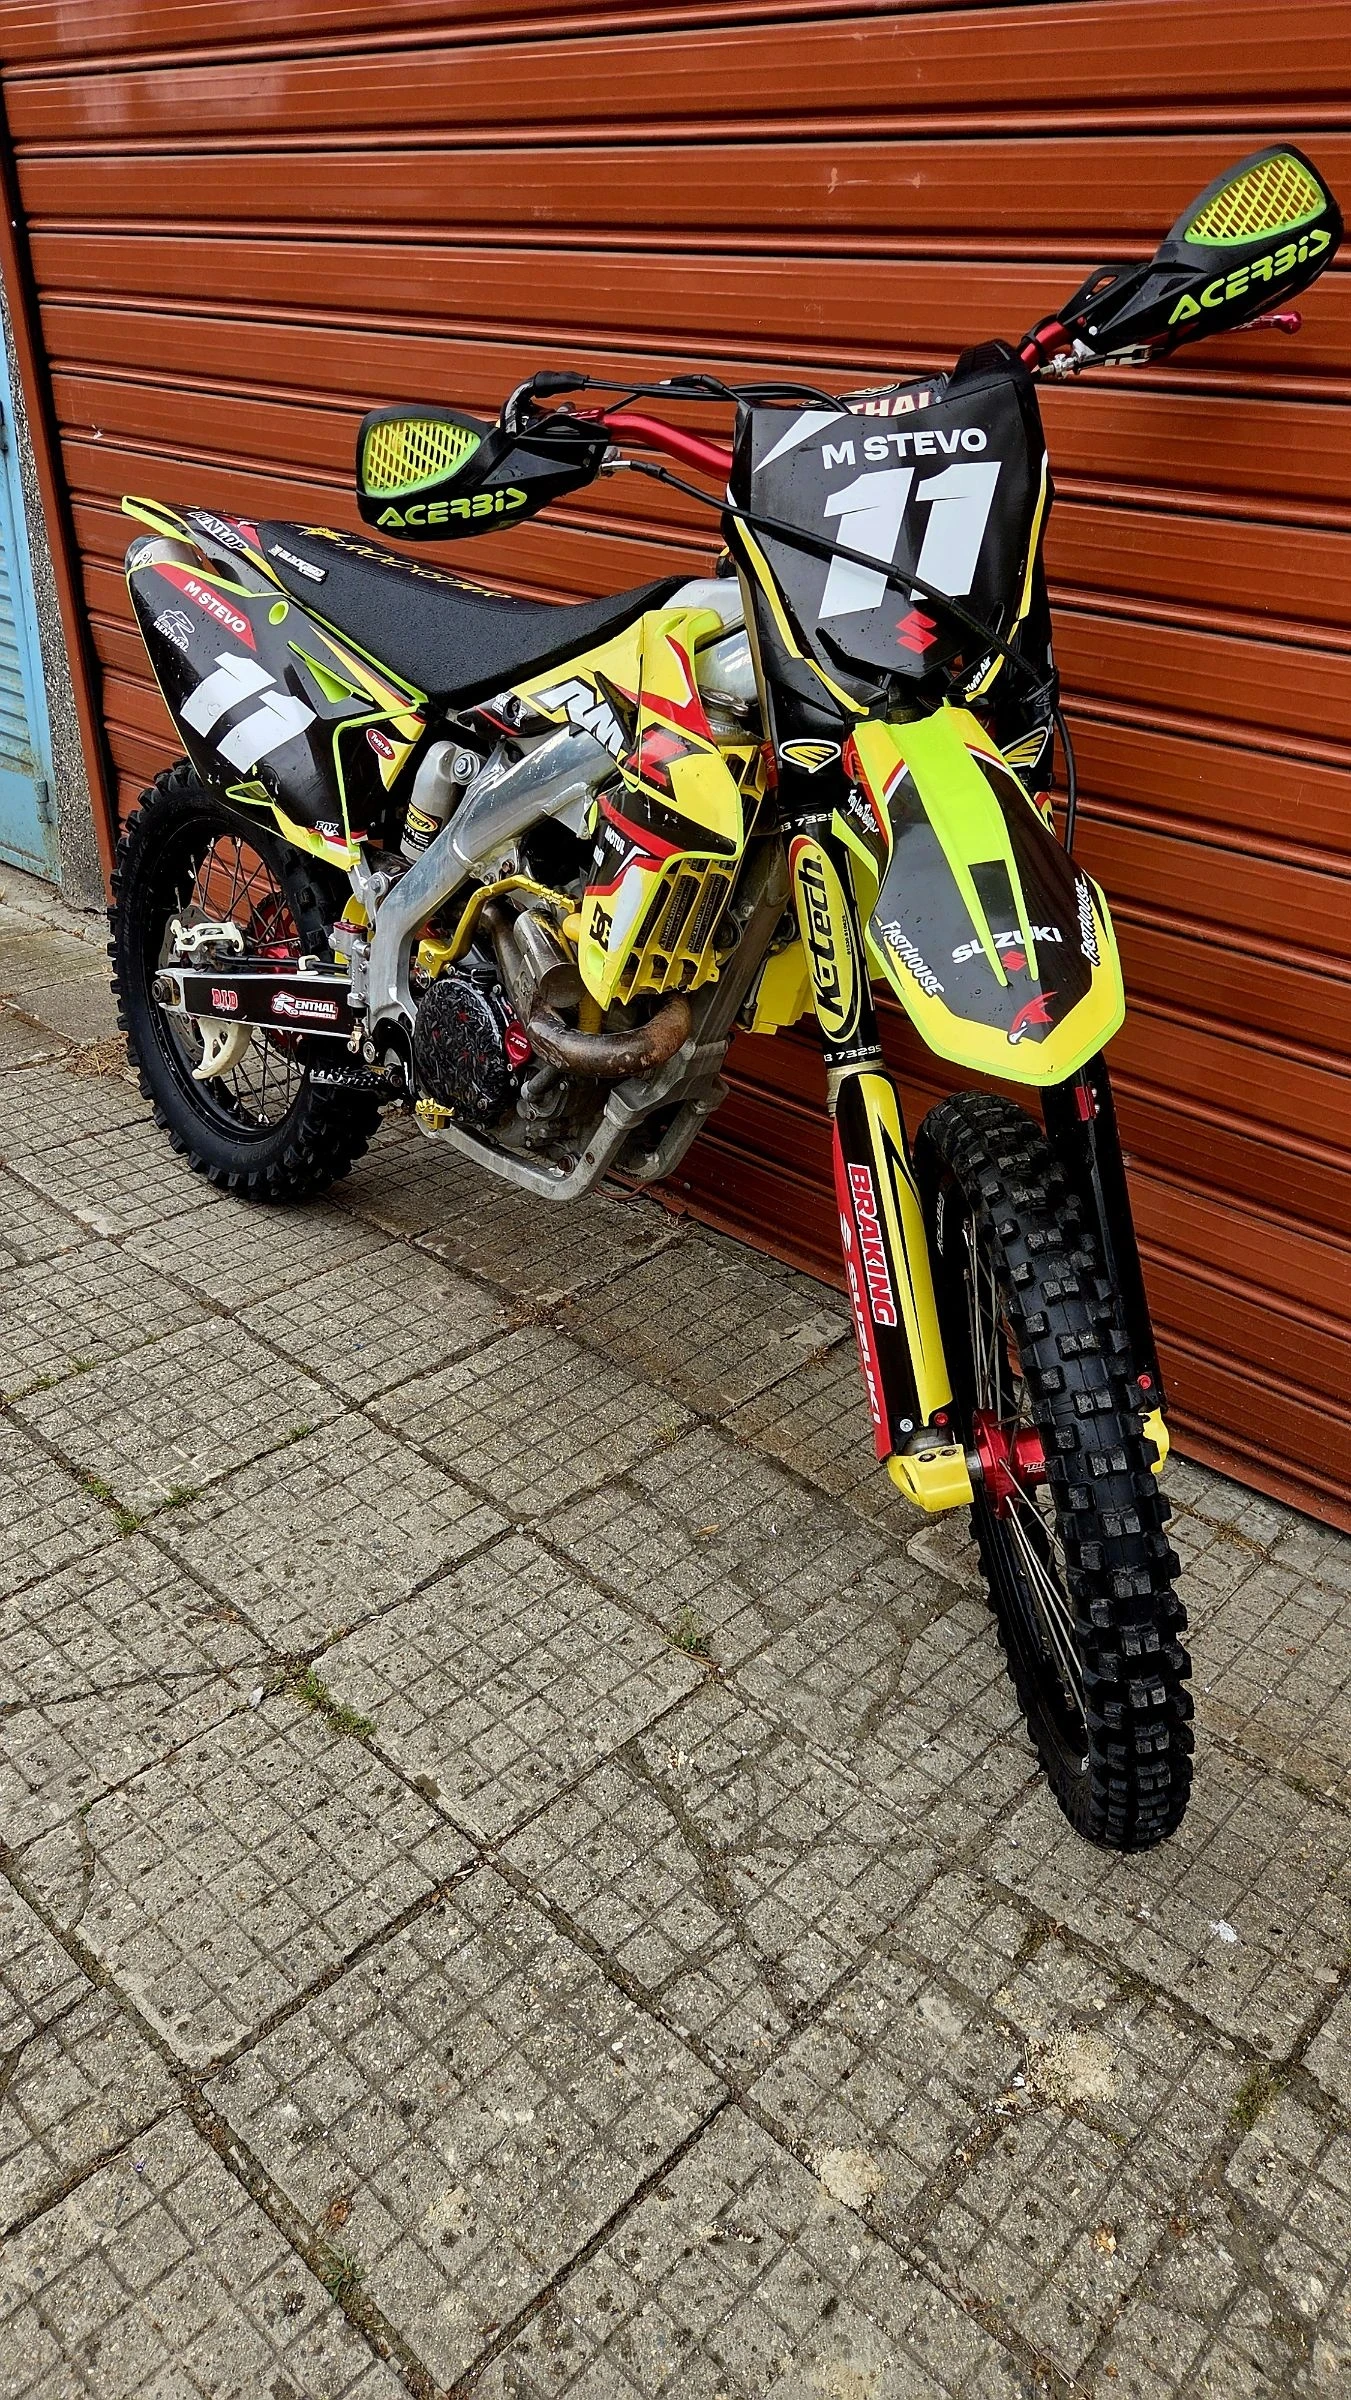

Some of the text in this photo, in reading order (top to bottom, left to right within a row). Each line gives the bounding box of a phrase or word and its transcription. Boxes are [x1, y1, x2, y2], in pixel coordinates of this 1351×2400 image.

[1168, 229, 1331, 325] ACERBIS
[822, 428, 988, 470] M STEVO
[187, 511, 249, 550] DUNLOP
[376, 487, 527, 527] ACERBIS
[819, 461, 1002, 620] 11
[183, 581, 247, 633] M STEVO
[153, 620, 189, 653] RENTHAL
[180, 651, 317, 774] 11
[315, 821, 340, 836] FOX
[604, 825, 626, 856] MOTUL
[951, 926, 1063, 964] SUZUKI
[1074, 877, 1100, 967] FASTHOUSE
[881, 920, 944, 998] FASTHOUSE
[847, 1162, 898, 1327] BRAKING
[848, 1261, 882, 1424] SUZUKI
